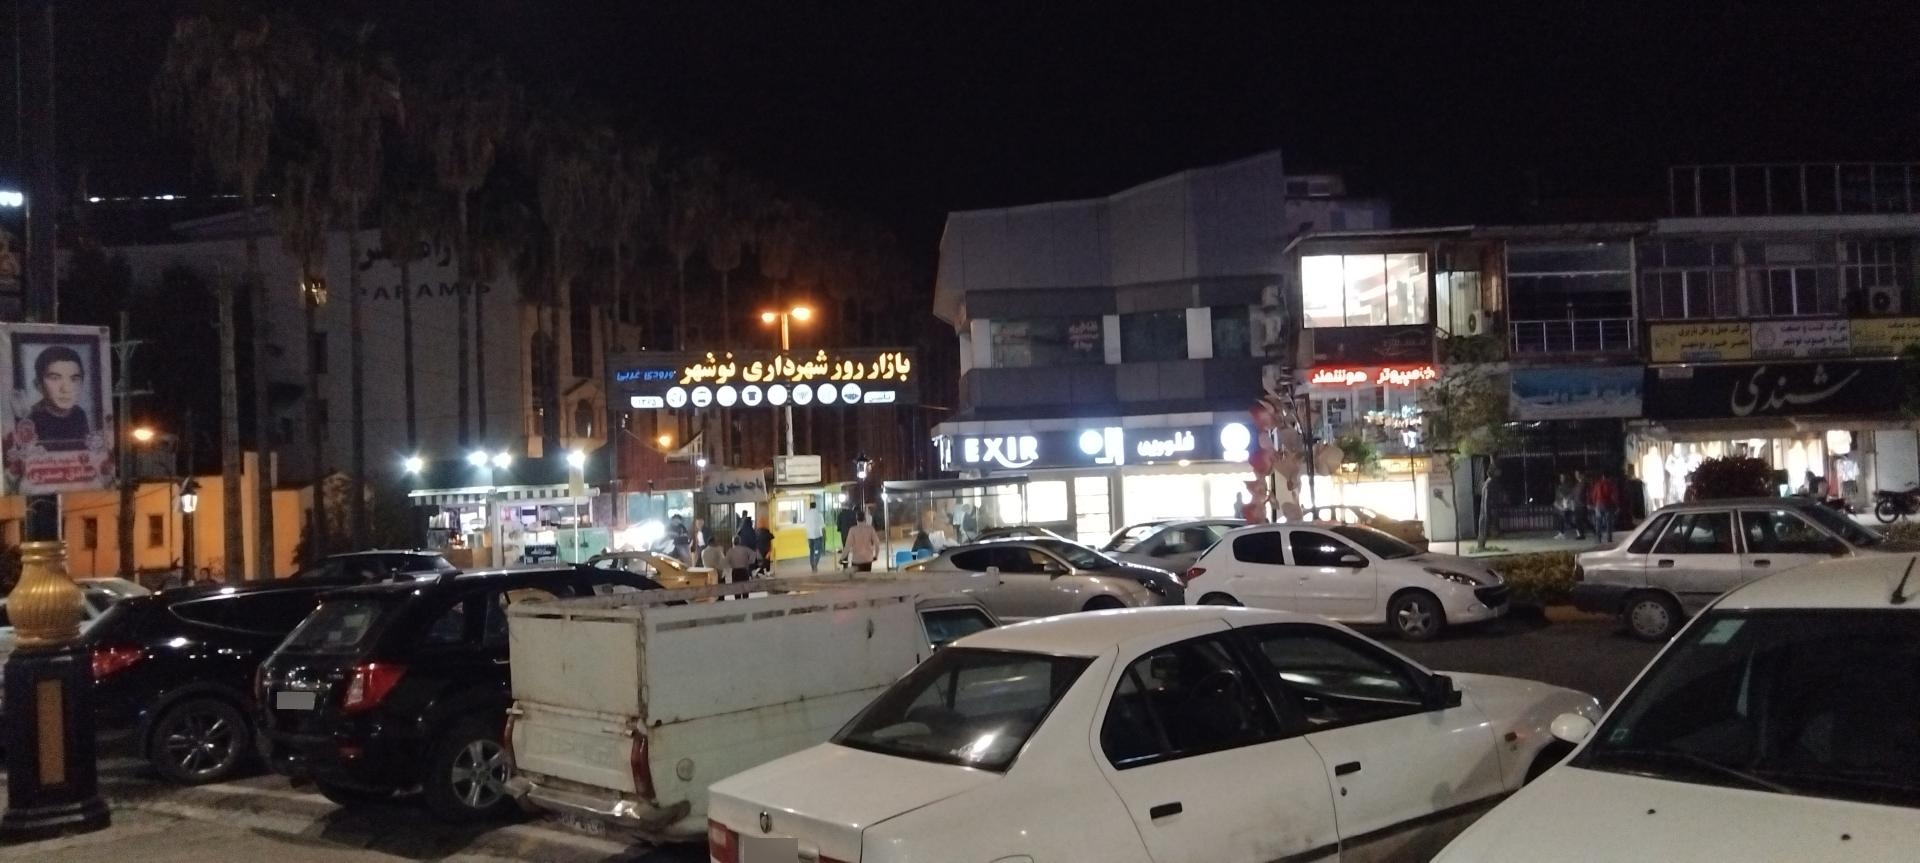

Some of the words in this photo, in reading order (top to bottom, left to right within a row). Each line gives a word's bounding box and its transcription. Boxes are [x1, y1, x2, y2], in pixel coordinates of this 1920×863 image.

[616, 369, 641, 382] غربی
[644, 370, 675, 381] ورودی
[680, 352, 736, 384] نوشهر
[743, 350, 828, 381] شهرداری
[867, 352, 911, 382] بازار
[1312, 369, 1367, 386] هوشمند
[1731, 365, 1861, 417] شندی
[965, 436, 1039, 468] EXIR
